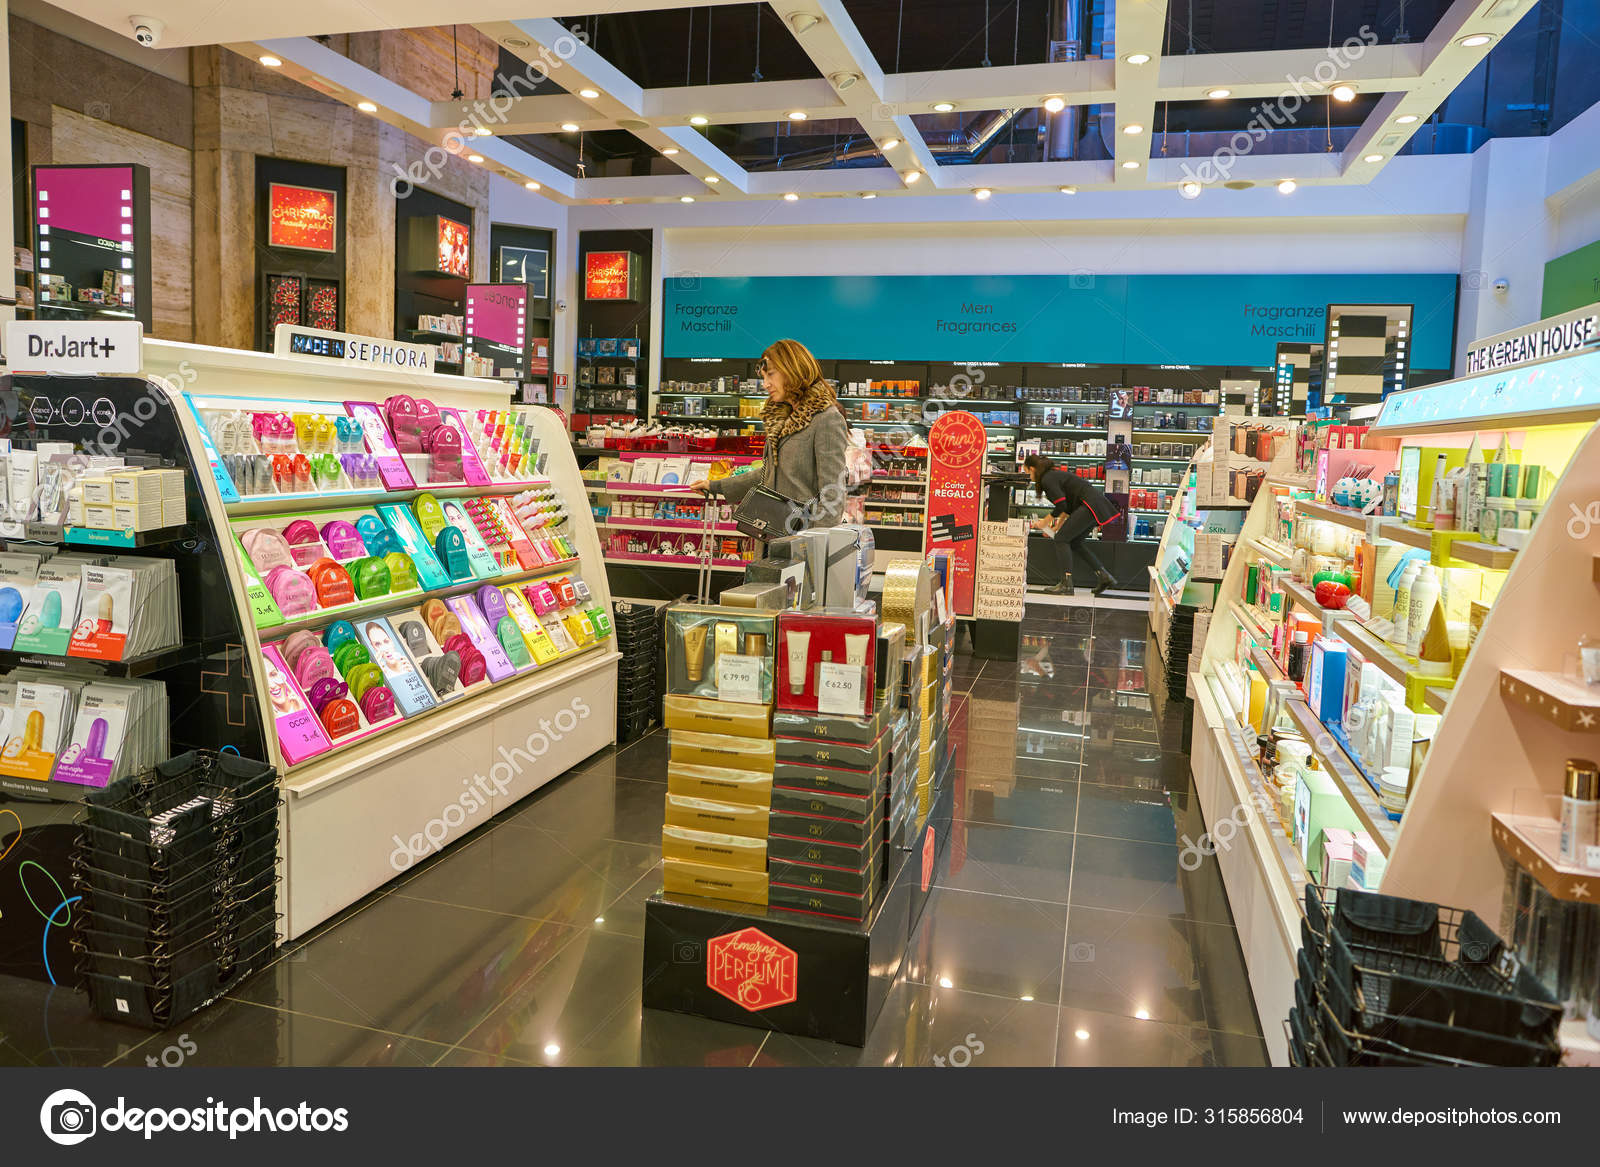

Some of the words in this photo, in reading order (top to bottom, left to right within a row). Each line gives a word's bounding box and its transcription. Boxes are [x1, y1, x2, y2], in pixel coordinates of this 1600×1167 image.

[675, 303, 738, 318] Fragranze
[960, 301, 993, 314] Men
[1243, 304, 1325, 321] Fragranze
[936, 318, 1017, 335] Fragrances
[1250, 323, 1316, 337] Maschili
[28, 334, 116, 359] Dr.Jart+
[293, 335, 329, 354] MADE
[332, 341, 344, 357] IN
[349, 341, 428, 368] SEPHORA
[1467, 348, 1486, 373] THE
[1541, 317, 1593, 357] HOUSE
[933, 414, 981, 439] BEAUTY
[945, 481, 965, 489] Carta
[934, 489, 974, 498] REGALO
[248, 591, 265, 600] VISO
[978, 608, 1020, 618] SEPHORA
[730, 673, 750, 682] 79.90
[831, 681, 852, 690] 62.50
[289, 716, 311, 729] OCCHI
[719, 933, 782, 961] Amazing
[714, 945, 793, 998] PERFUME
